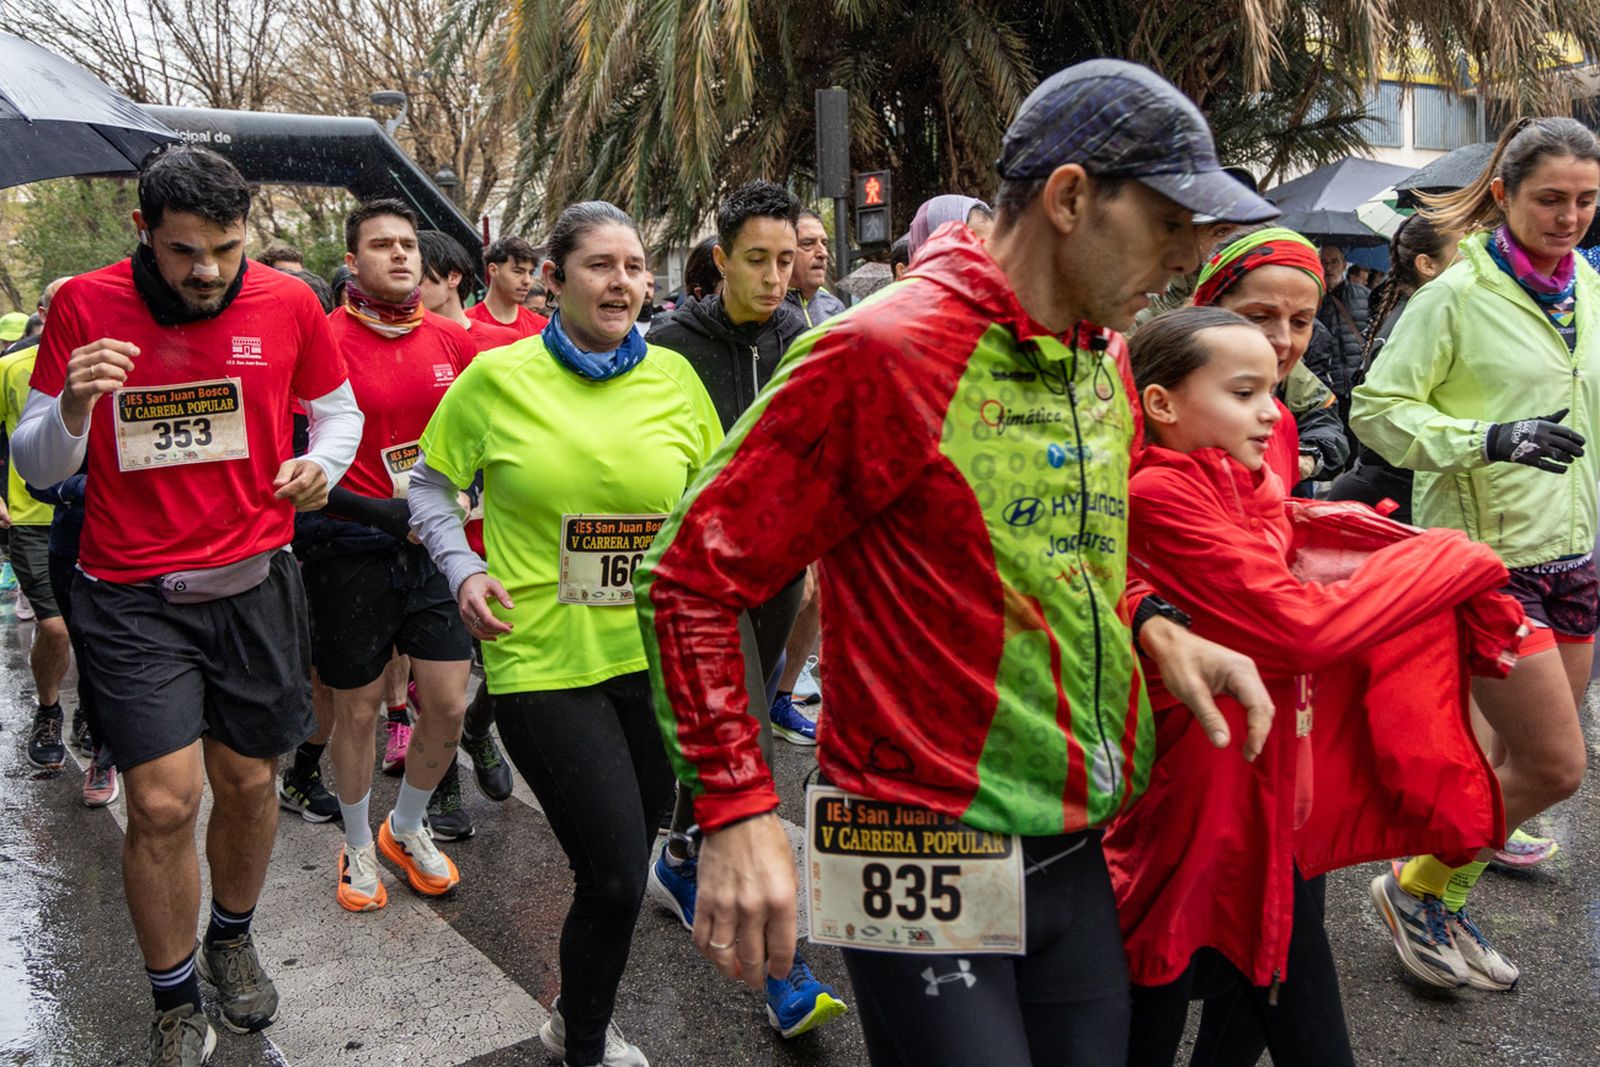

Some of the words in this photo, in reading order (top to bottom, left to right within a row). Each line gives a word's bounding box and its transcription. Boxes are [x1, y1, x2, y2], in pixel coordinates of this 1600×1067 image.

[213, 131, 232, 144] de
[126, 394, 143, 405] IES
[145, 392, 167, 404] San
[169, 389, 196, 402] Juan
[197, 386, 230, 398] Bosco
[124, 407, 132, 419] V
[135, 404, 184, 420] CARRERA
[186, 398, 235, 414] POPULAR
[152, 417, 213, 450] 353
[575, 521, 593, 534] IES
[595, 521, 615, 534] San
[618, 521, 643, 534] Juan
[571, 536, 580, 549] V
[582, 536, 630, 549] CARRERA
[826, 802, 852, 824] IES
[856, 804, 890, 826] San
[894, 806, 938, 826] Juan
[821, 826, 834, 849] V
[838, 827, 918, 854] CARRERA
[922, 830, 1006, 855] POPULAR
[862, 862, 962, 922] 835
